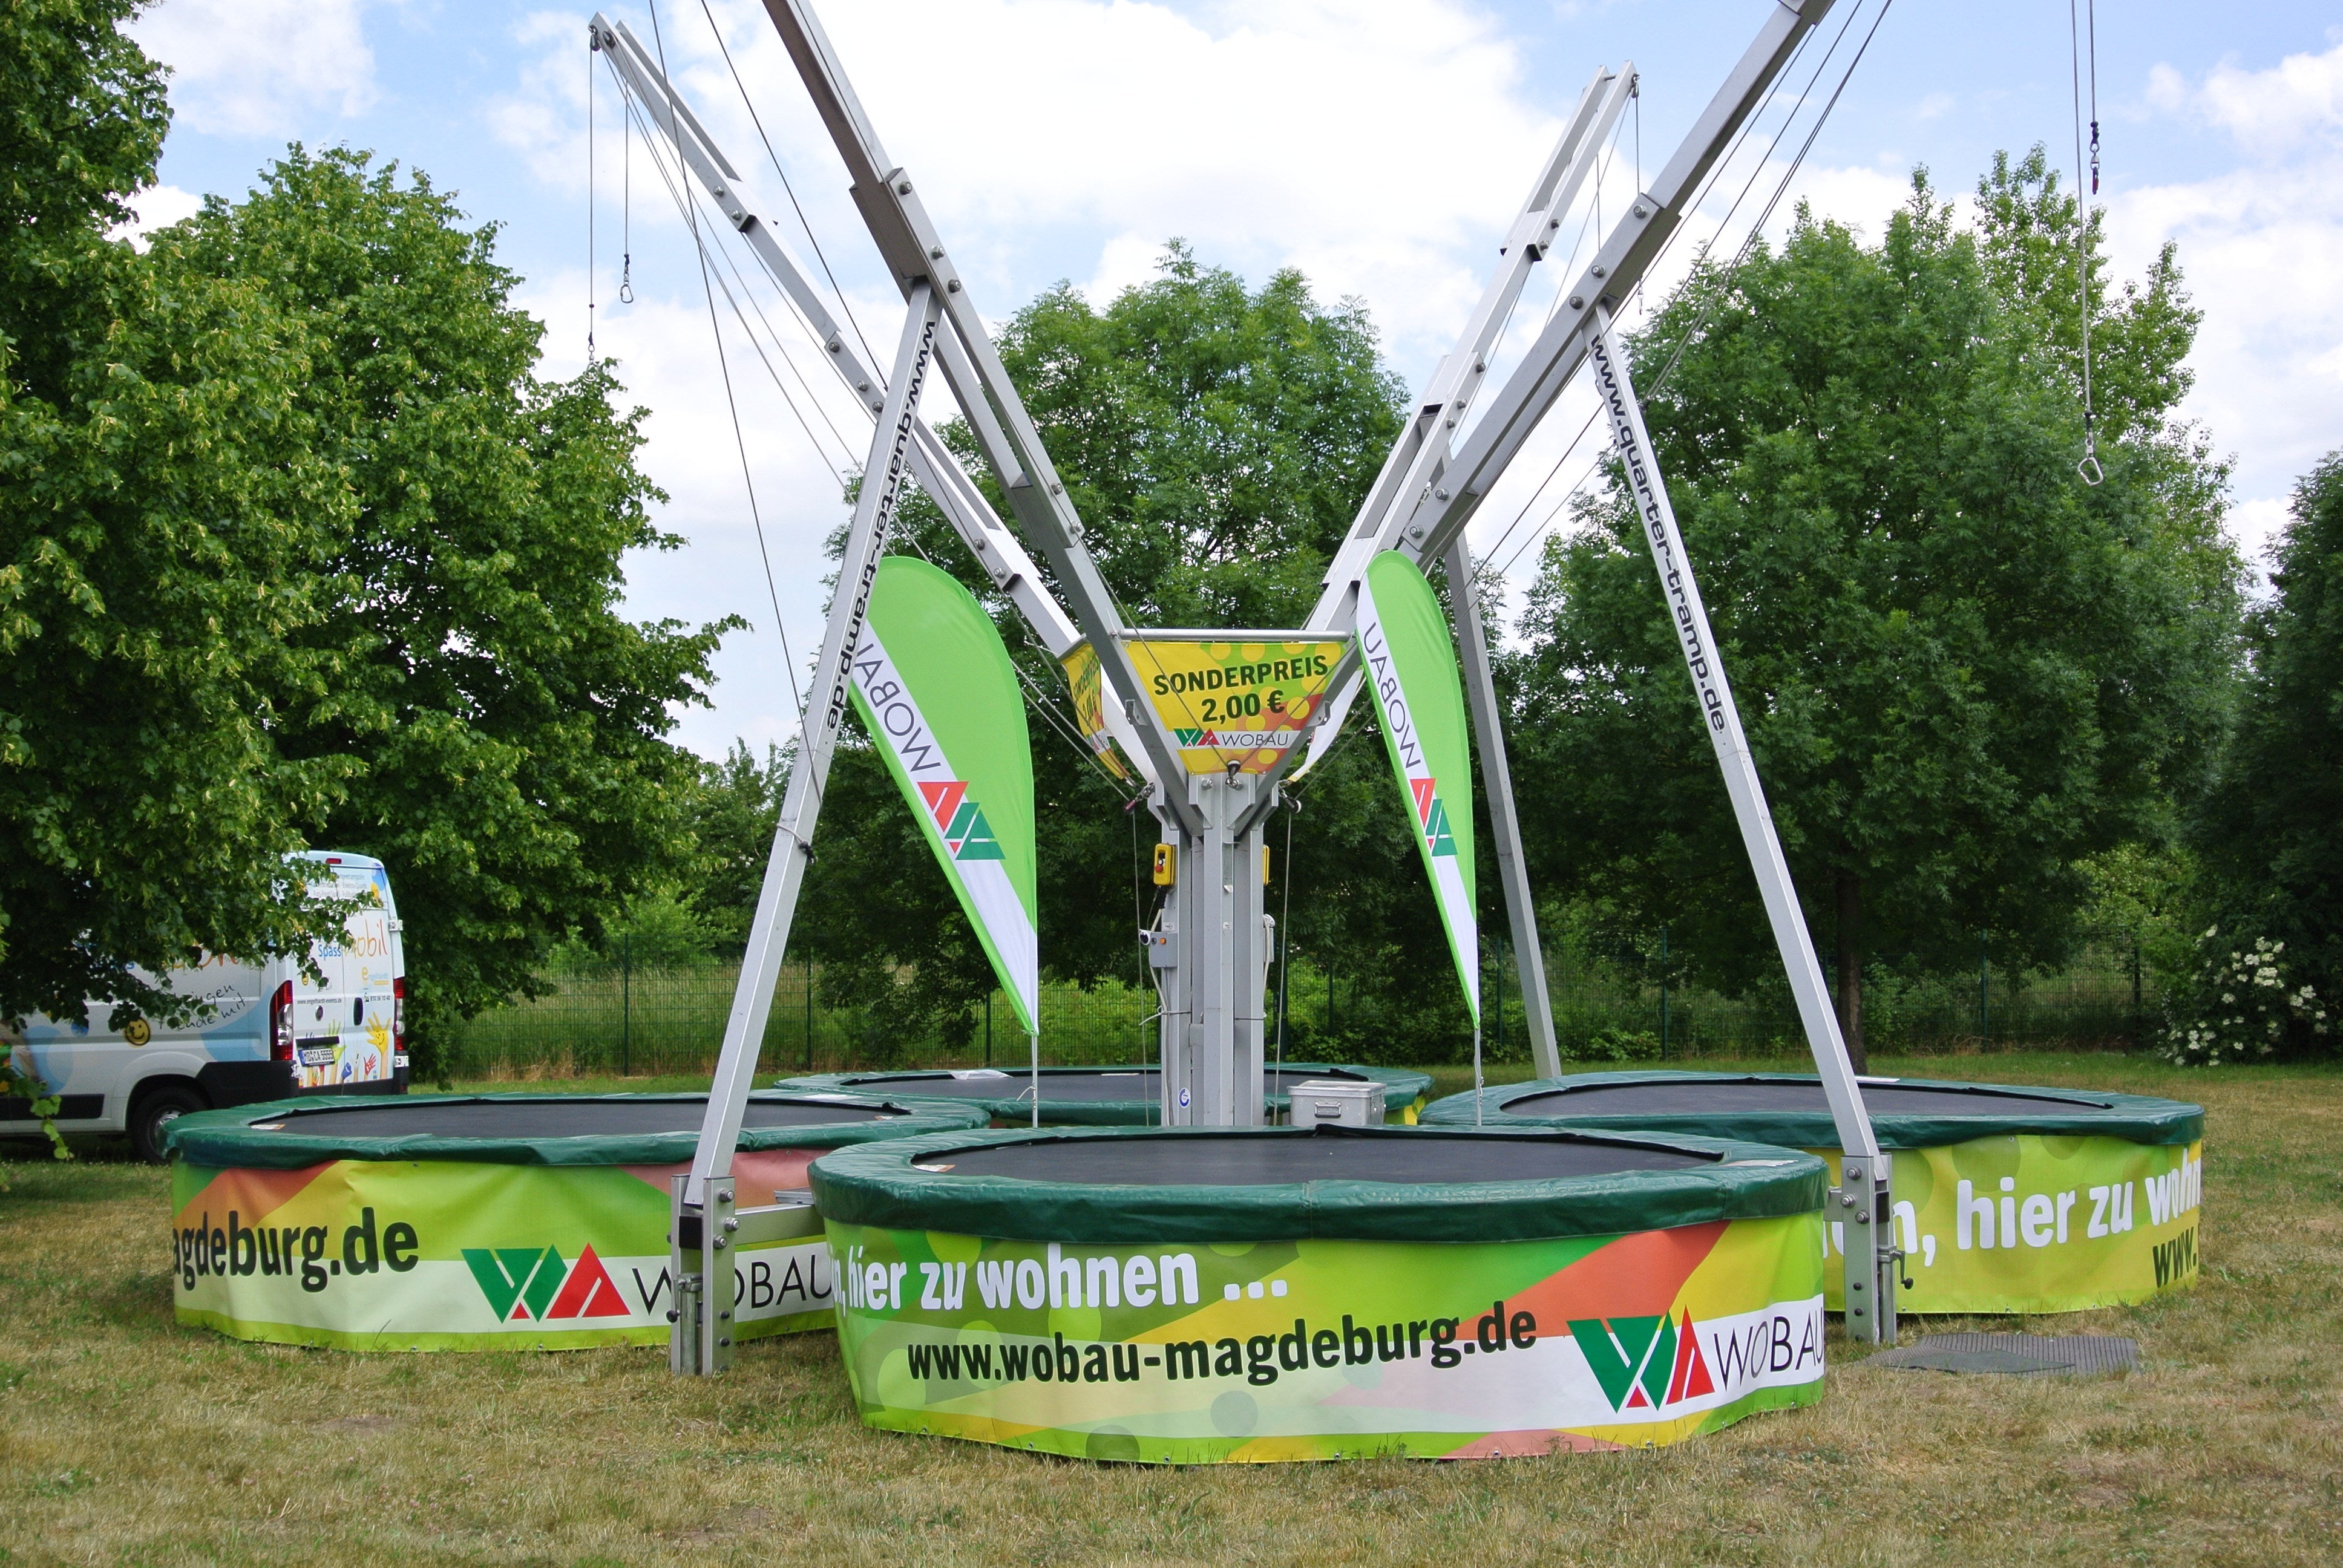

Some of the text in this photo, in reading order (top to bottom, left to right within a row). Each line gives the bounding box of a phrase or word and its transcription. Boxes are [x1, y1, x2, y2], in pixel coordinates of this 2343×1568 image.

[827, 321, 936, 731] www.quarter-tramp.de
[1590, 334, 1725, 733] www.quarter-tramp.de
[1153, 655, 1328, 696] SONDERPREIS
[1201, 690, 1285, 725] 2,00 €
[1221, 733, 1289, 746] WOBAU
[318, 944, 342, 961] Spass
[221, 992, 246, 1019] mit
[1956, 1176, 2076, 1250] hier
[2087, 1180, 2134, 1239] zu
[631, 1254, 832, 1316] WBAU
[848, 1245, 907, 1310] hier
[919, 1260, 966, 1310] zu
[976, 1243, 1199, 1310] wohnen
[908, 1300, 1538, 1386] www.wobau-magdeburg.de
[1713, 1307, 1824, 1392] WOBAU
